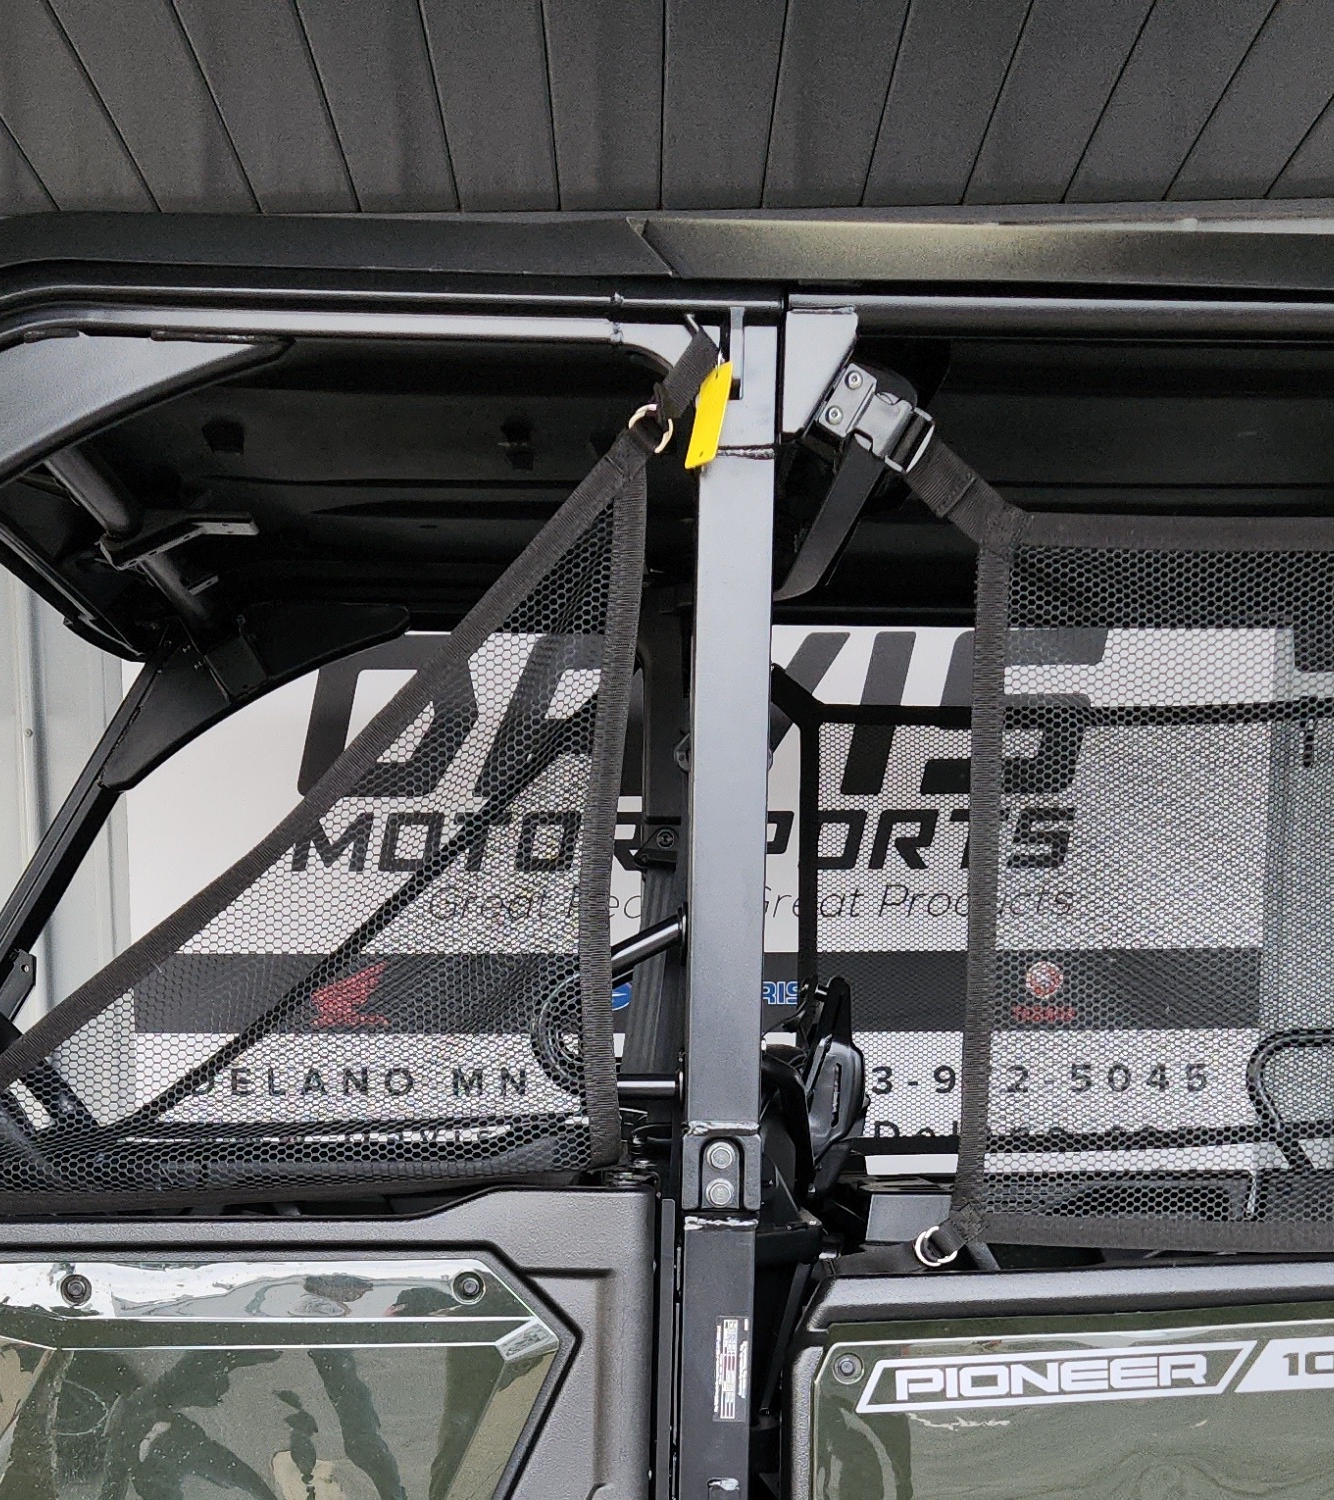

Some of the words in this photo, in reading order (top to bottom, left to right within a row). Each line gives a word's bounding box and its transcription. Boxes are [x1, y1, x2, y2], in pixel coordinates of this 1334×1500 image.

[290, 807, 1076, 873] MOTOORTS
[878, 883, 1075, 917] Procts
[452, 1066, 528, 1097] MN
[895, 1353, 1207, 1402] PIONEER
